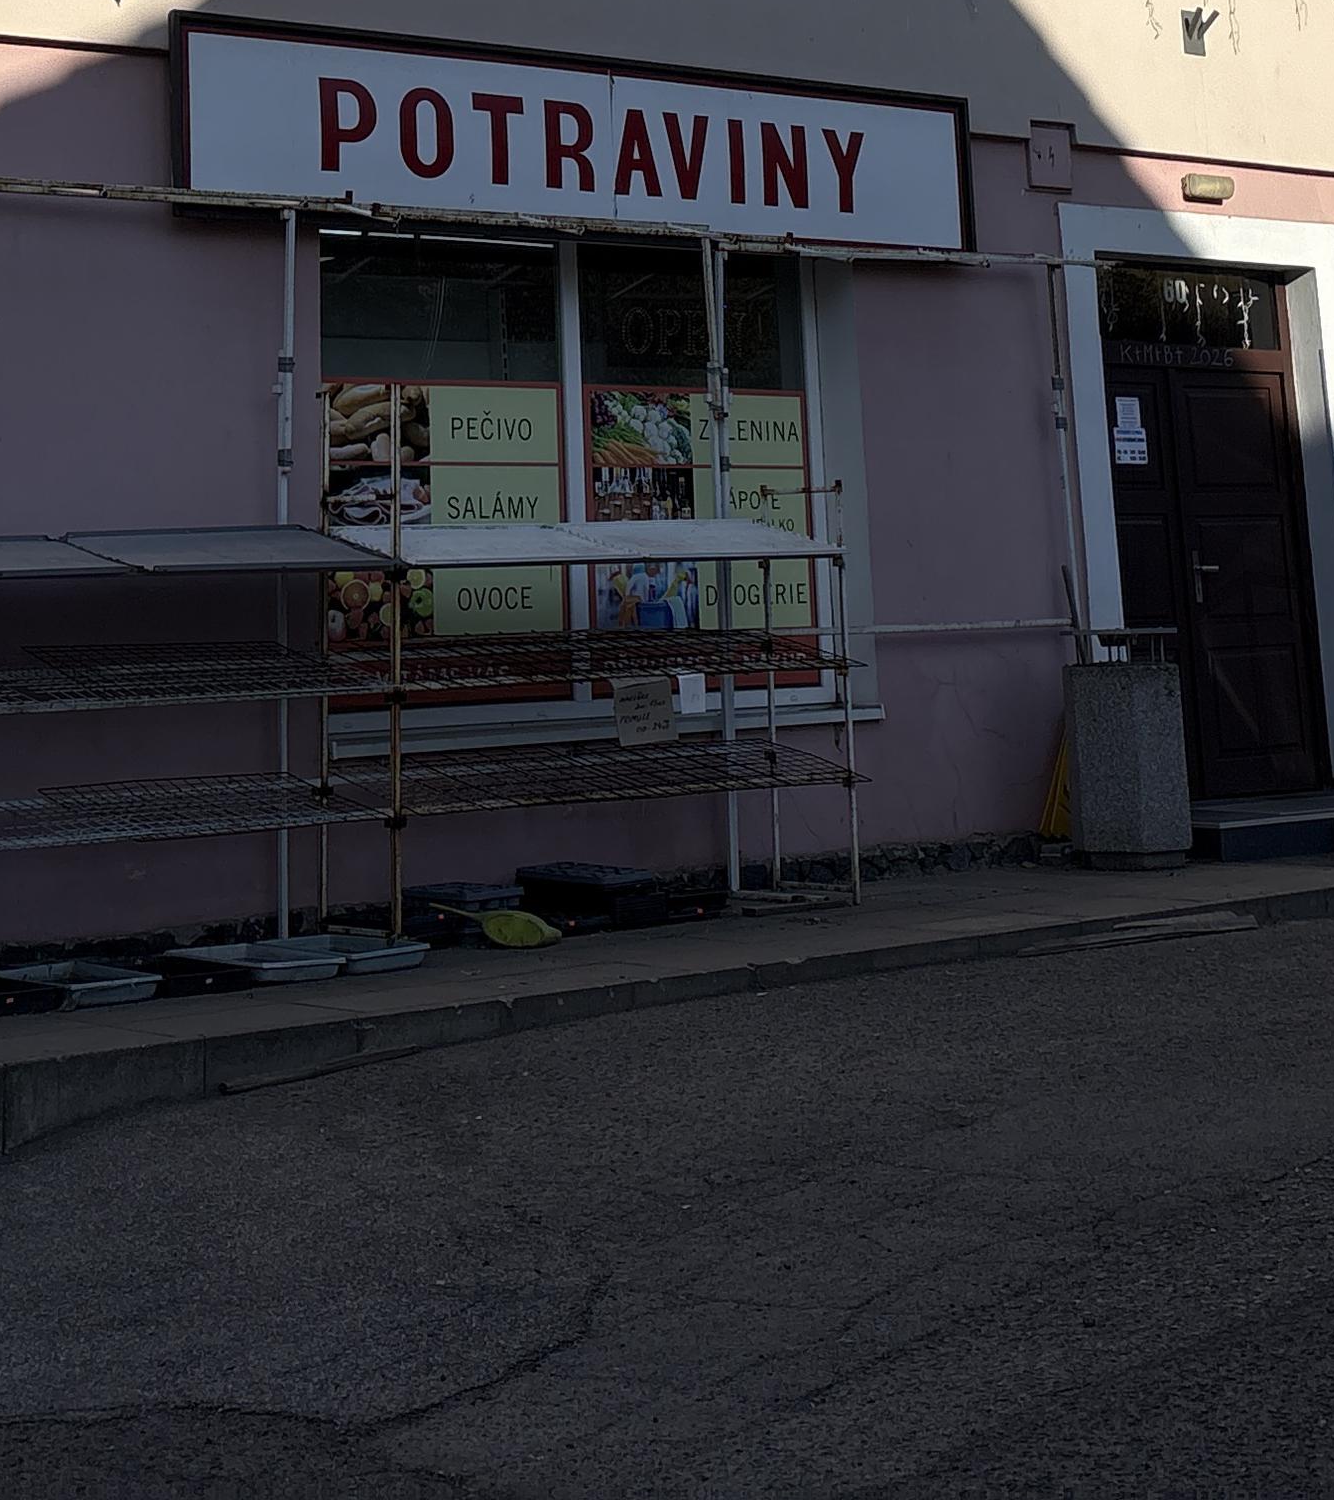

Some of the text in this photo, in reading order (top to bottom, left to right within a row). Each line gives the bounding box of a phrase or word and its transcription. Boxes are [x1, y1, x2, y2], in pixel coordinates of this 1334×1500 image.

[319, 76, 864, 214] POTRAVINY
[1190, 347, 1234, 367] 2026
[451, 411, 533, 441] PEČIVO
[447, 491, 538, 520] SALÁMY
[457, 586, 533, 611] OVOCE
[706, 583, 807, 606] DOGRIE
